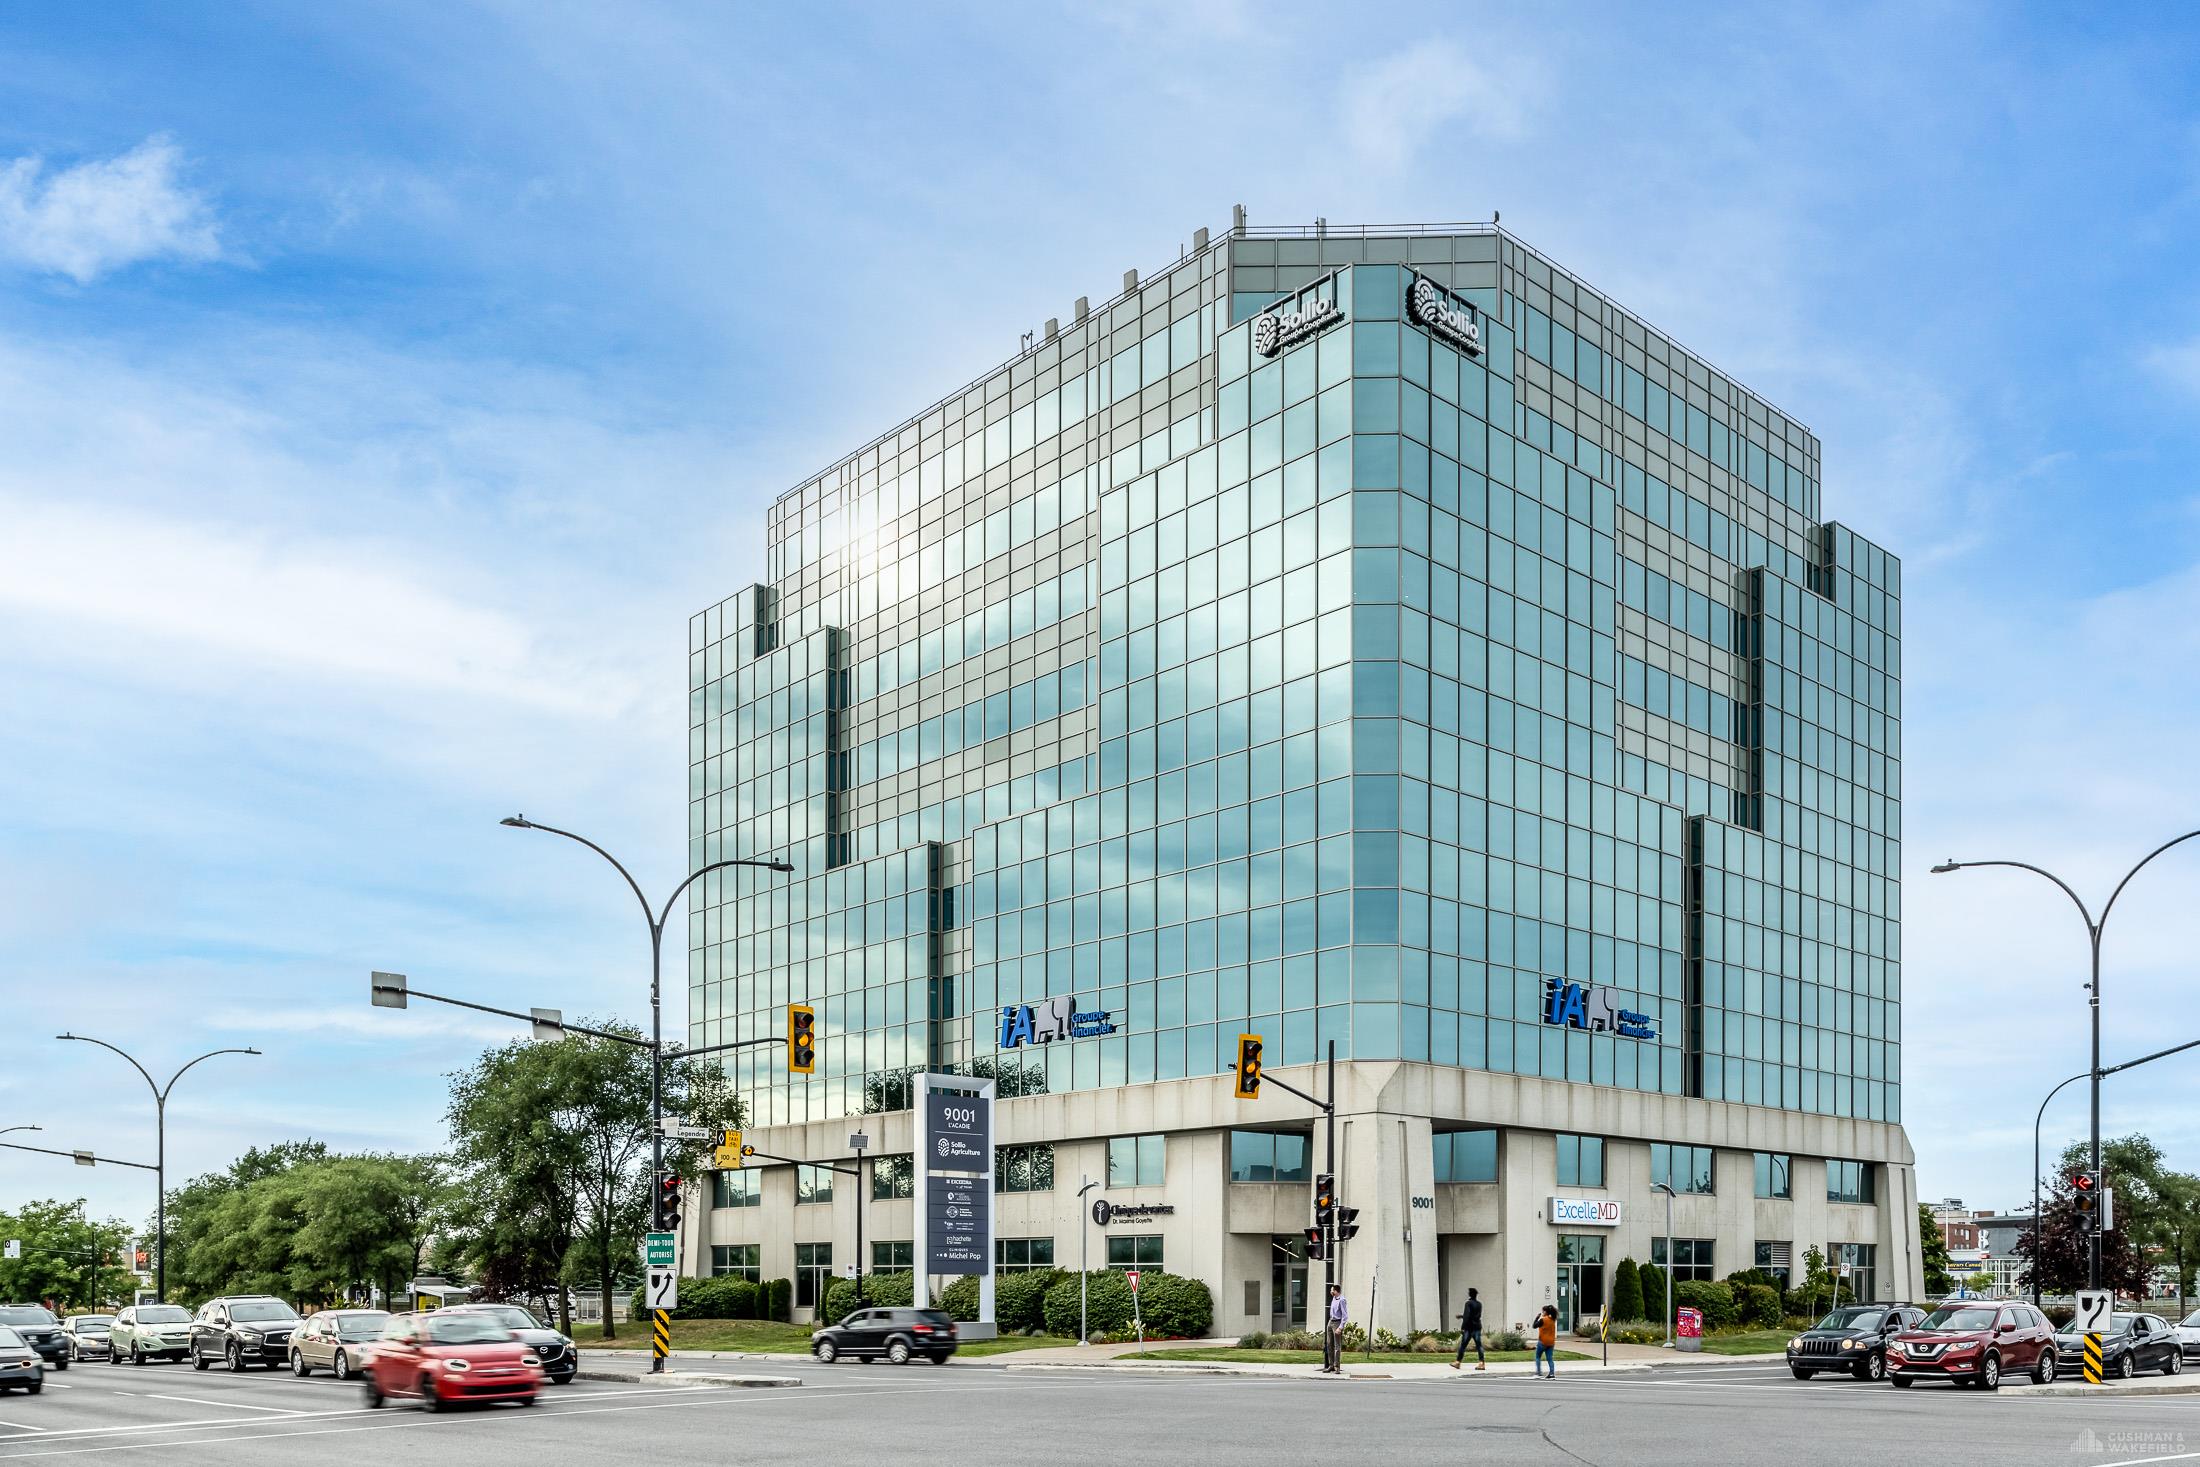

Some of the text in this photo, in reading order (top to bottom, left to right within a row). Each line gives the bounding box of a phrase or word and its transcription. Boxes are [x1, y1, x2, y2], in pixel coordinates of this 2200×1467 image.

[1279, 297, 1330, 335] Sollio
[1437, 300, 1479, 341] Sollio
[1279, 326, 1303, 344] Groupe
[1072, 1011, 1105, 1023] Groupe
[1621, 1009, 1651, 1025] Groupe
[944, 1107, 975, 1123] 9001
[948, 1122, 971, 1130] L'ACADIE
[677, 1130, 706, 1138] Legendre
[950, 1141, 966, 1149] Sollio
[950, 1148, 981, 1156] Agriculture
[1412, 1196, 1434, 1209] 9001
[1556, 1200, 1618, 1220] ExcelleMD
[647, 1239, 674, 1247] DEMI-TOUR
[649, 1249, 673, 1259] AUTORISÉ
[969, 1252, 981, 1260] Pop
